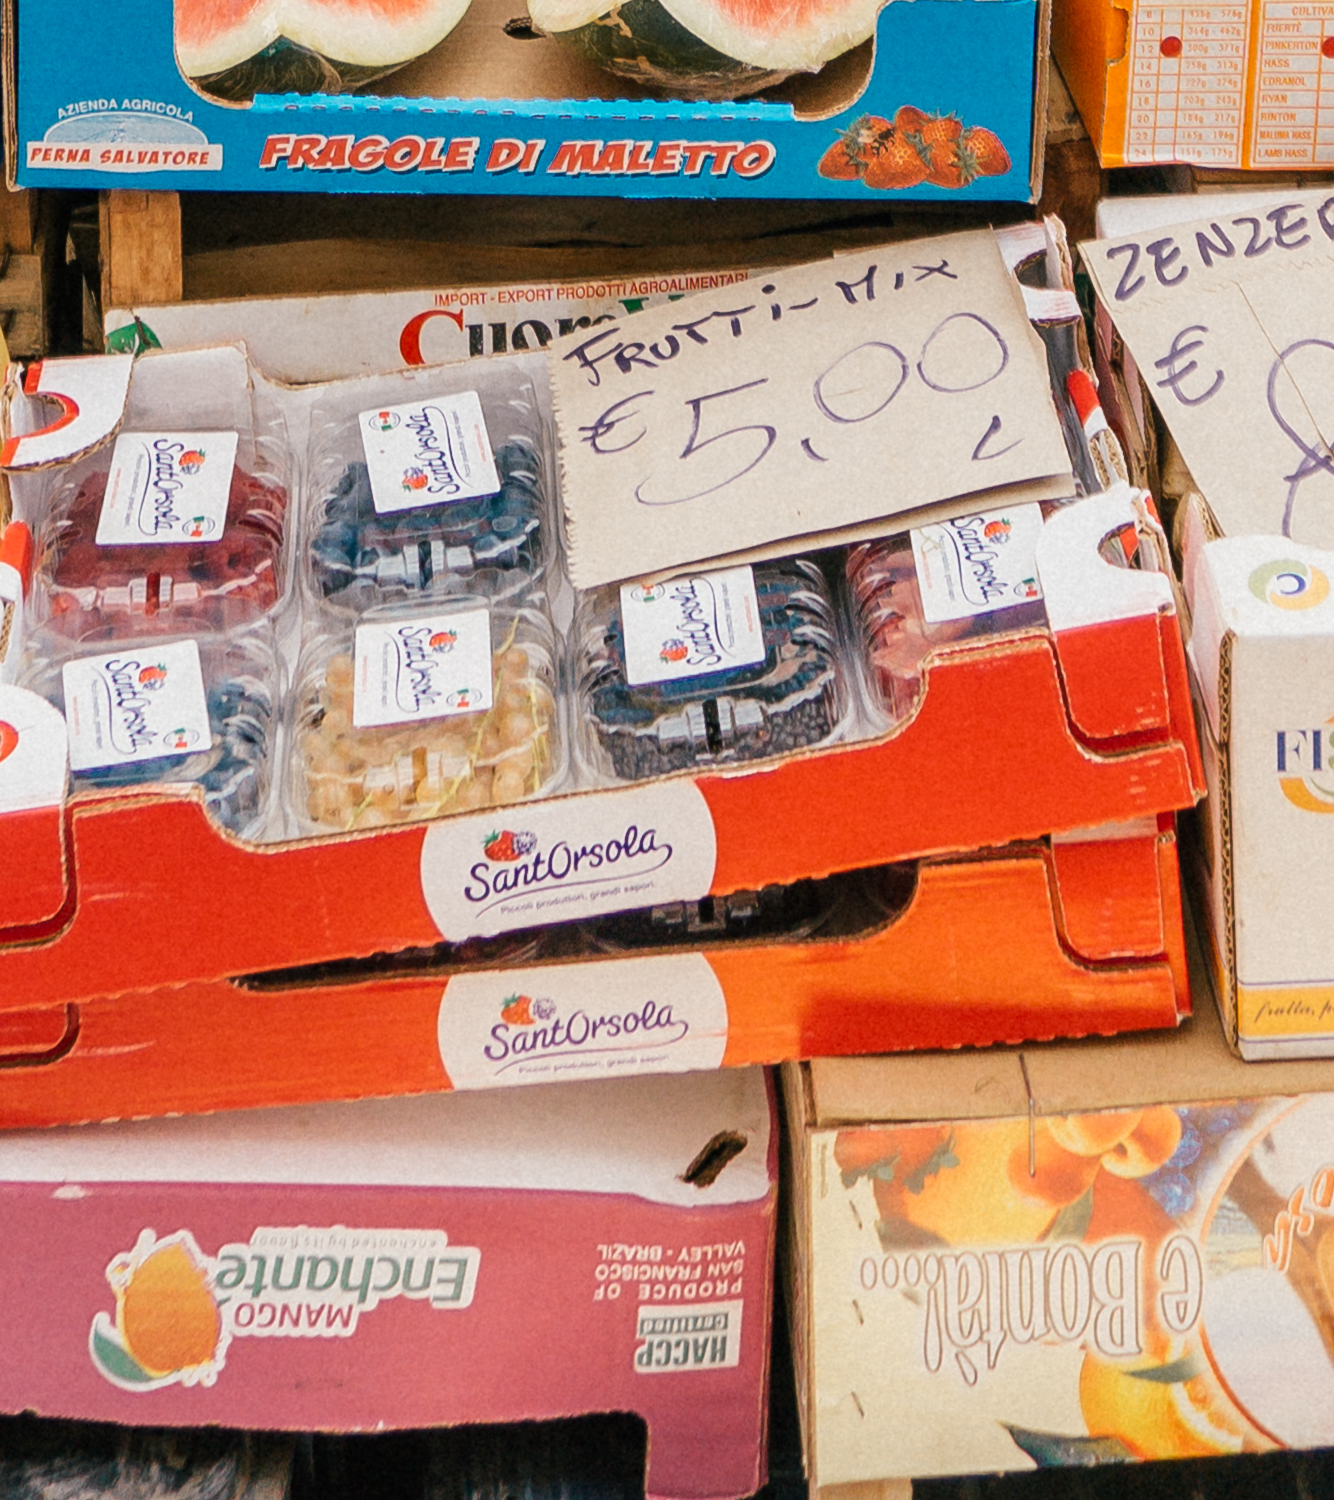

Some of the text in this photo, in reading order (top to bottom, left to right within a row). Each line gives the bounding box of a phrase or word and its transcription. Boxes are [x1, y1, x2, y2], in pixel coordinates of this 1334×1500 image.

[1265, 40, 1318, 51] PINKERTON
[1263, 58, 1291, 68] HASS
[57, 97, 195, 123] AZIENDA AGRICOLA
[29, 147, 210, 167] PERNA SALVATORE
[259, 133, 776, 177] FRAGOLE DI MALETTO
[433, 283, 627, 308] IMPORT EXPORT PRODOTTI
[1153, 323, 1226, 406] €
[579, 389, 655, 455] €
[636, 311, 1011, 508] 5,00
[463, 824, 673, 904] SantOrsola
[1254, 998, 1316, 1024] frutta,
[483, 999, 689, 1062] SantOrsola
[595, 1240, 747, 1263] VALLEY BRAZIL
[215, 1254, 468, 1308] Enchanté
[593, 1259, 745, 1282] SAN FRANCISCO
[1162, 1234, 1205, 1332] e
[591, 1277, 744, 1303] PRODUCE OF
[233, 1302, 354, 1330] MANGO
[639, 1312, 728, 1336] Certified
[637, 1336, 728, 1367] HACCP
